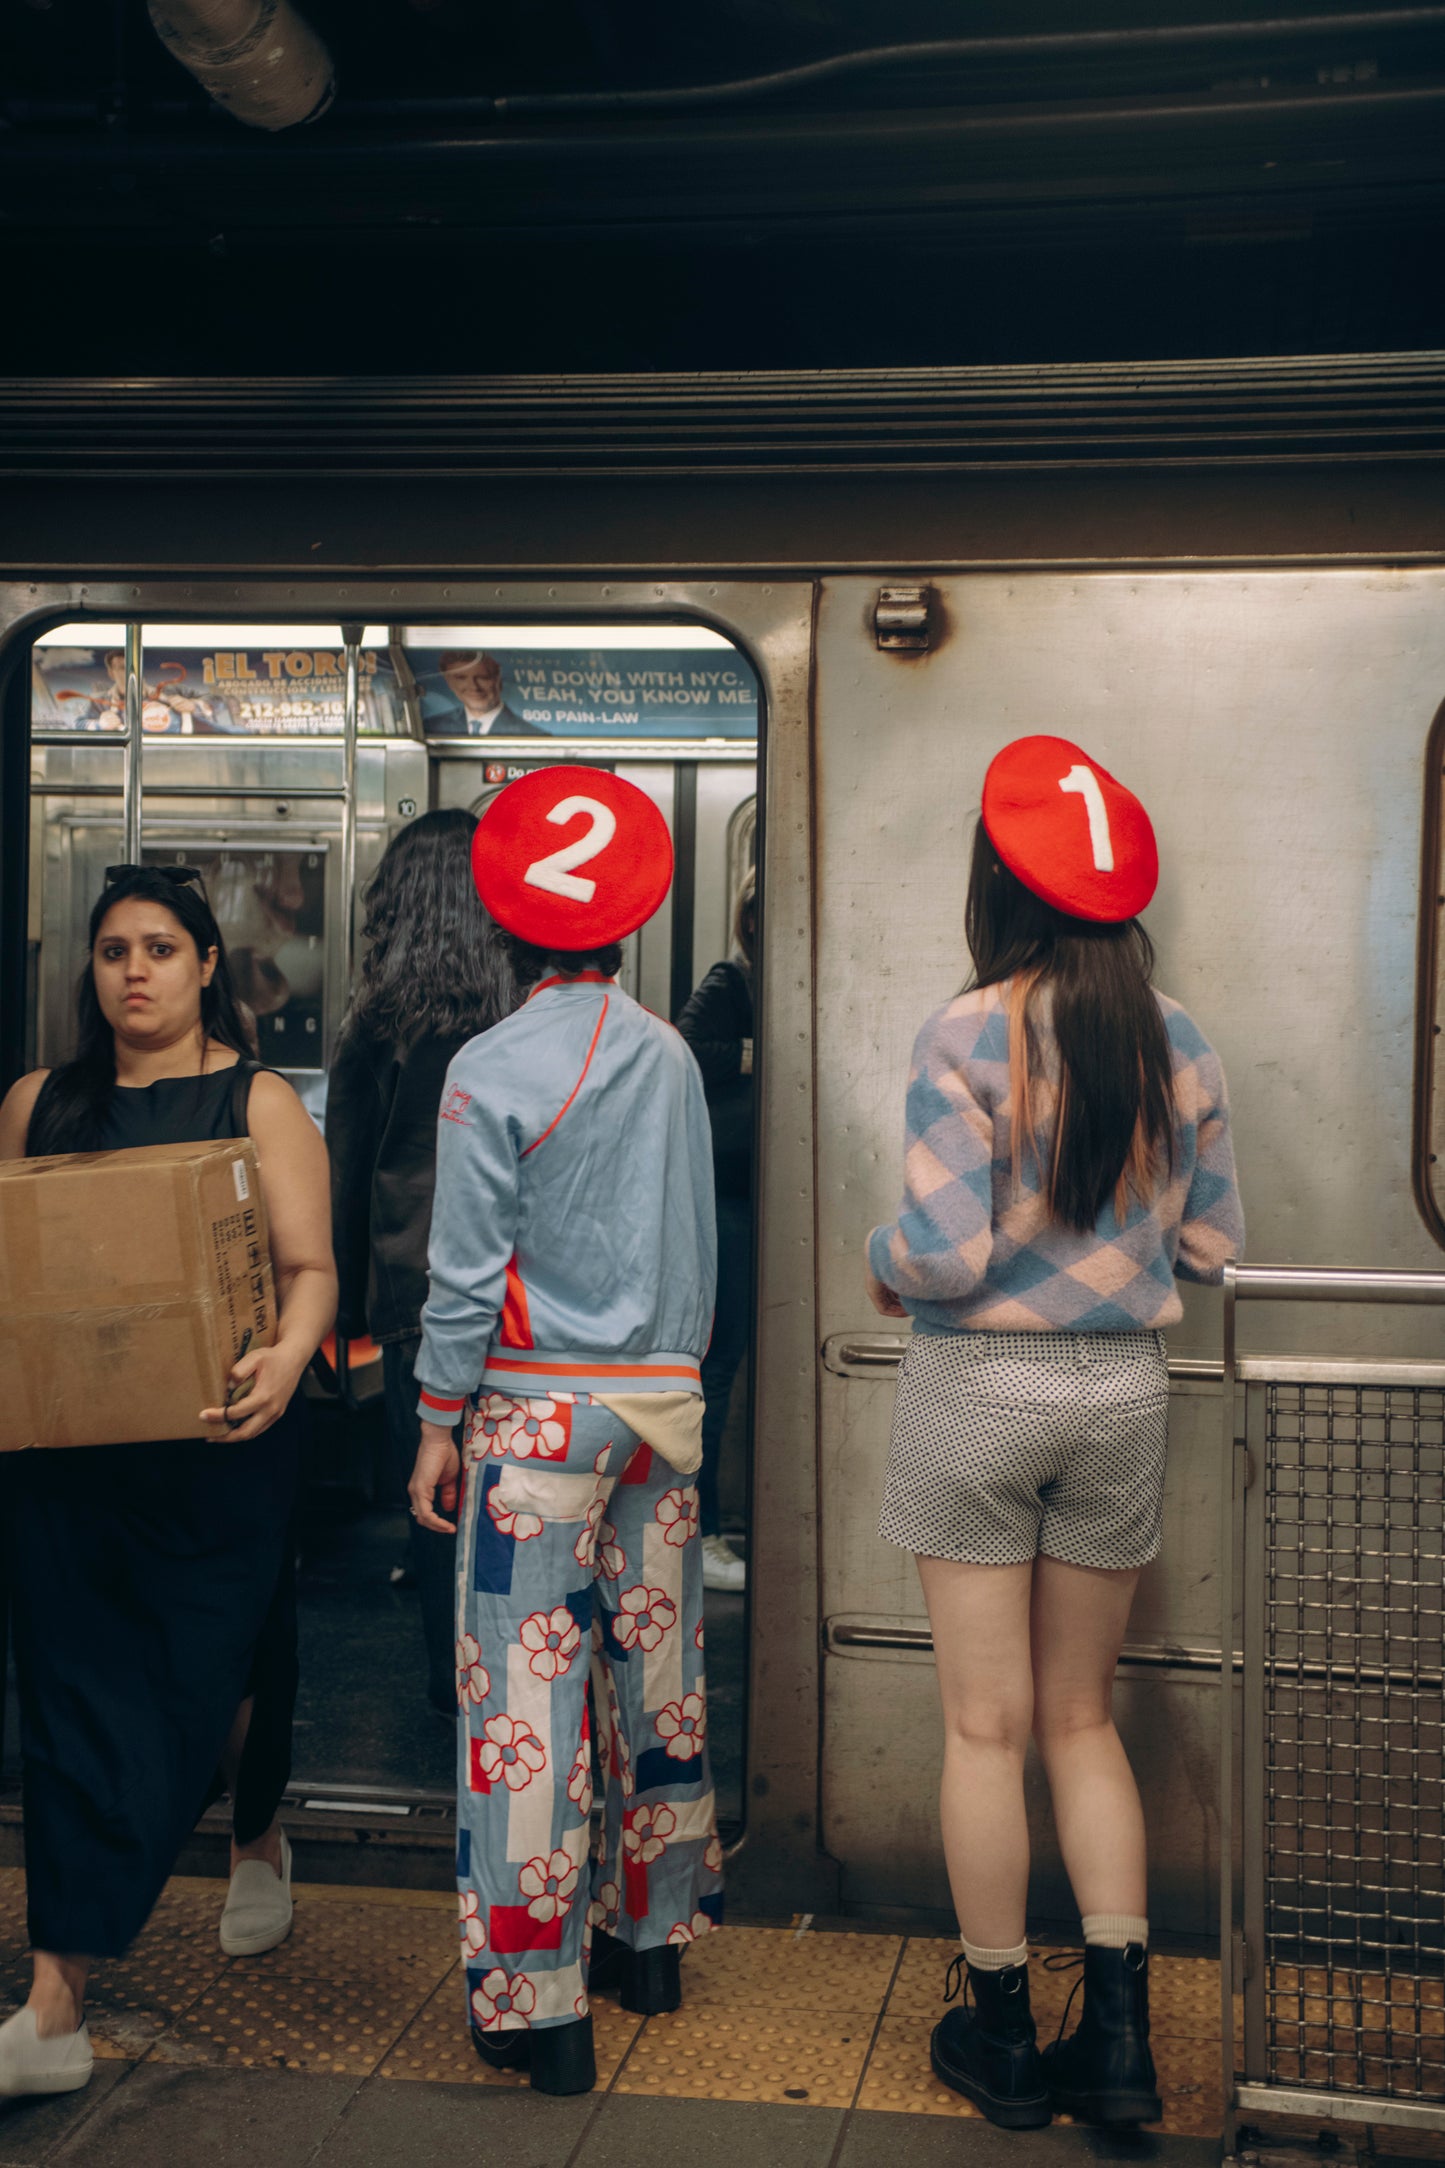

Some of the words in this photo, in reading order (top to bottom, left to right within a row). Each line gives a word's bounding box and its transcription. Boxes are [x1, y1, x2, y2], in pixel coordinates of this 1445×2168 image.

[289, 677, 345, 686] ACCIDENT
[513, 669, 547, 684] I'M
[552, 670, 621, 686] DOWN
[627, 671, 684, 686] WITH
[690, 671, 744, 686] NYC.
[517, 686, 583, 705] YEAH,
[588, 689, 636, 705] YOU
[642, 689, 711, 704] KNOW
[718, 689, 758, 704] ME.
[240, 700, 366, 718] 212-962-100
[522, 709, 552, 722] 800
[556, 710, 639, 724] PAIN-LAW
[401, 801, 415, 816] 10
[1058, 765, 1114, 873] 1
[524, 795, 617, 904] 2
